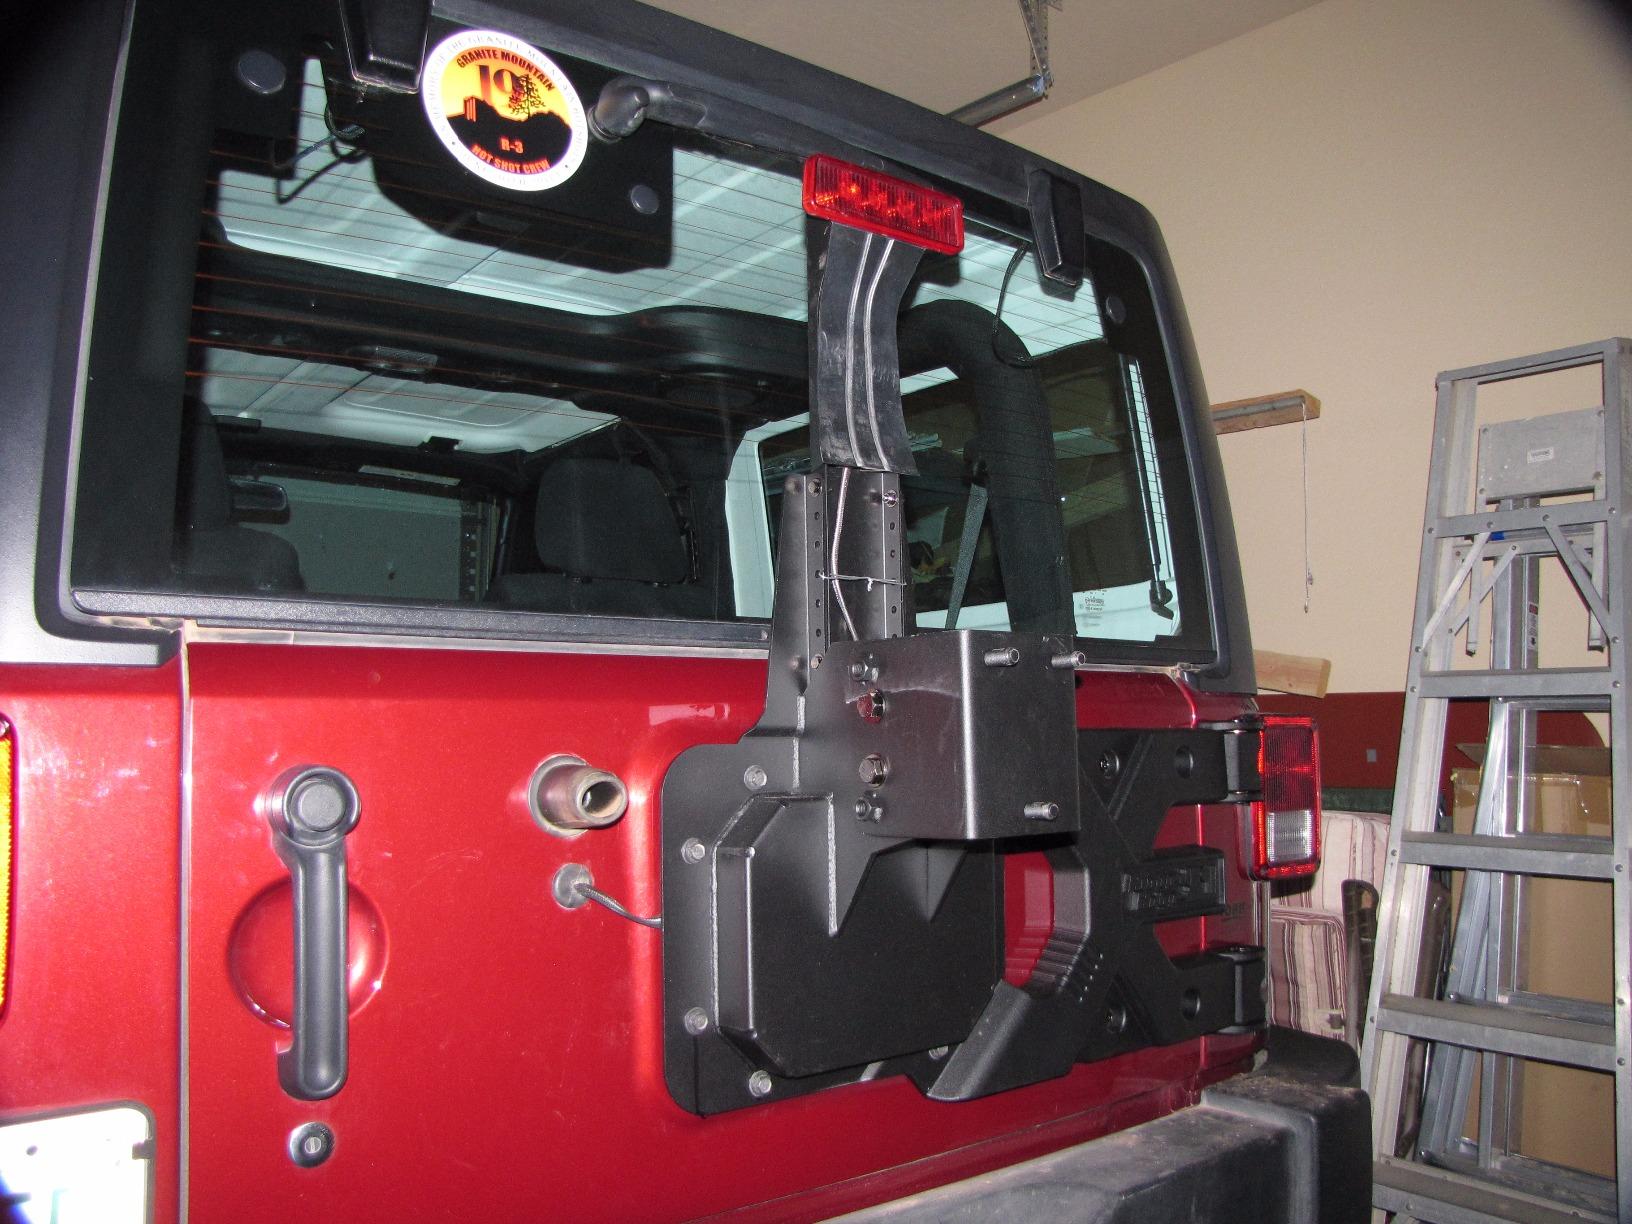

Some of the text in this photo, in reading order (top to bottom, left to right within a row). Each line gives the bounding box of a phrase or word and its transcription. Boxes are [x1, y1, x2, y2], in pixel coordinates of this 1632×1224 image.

[456, 49, 556, 91] GRANITE MOUNTAIN
[471, 144, 550, 174] HOT SHOT CREW
